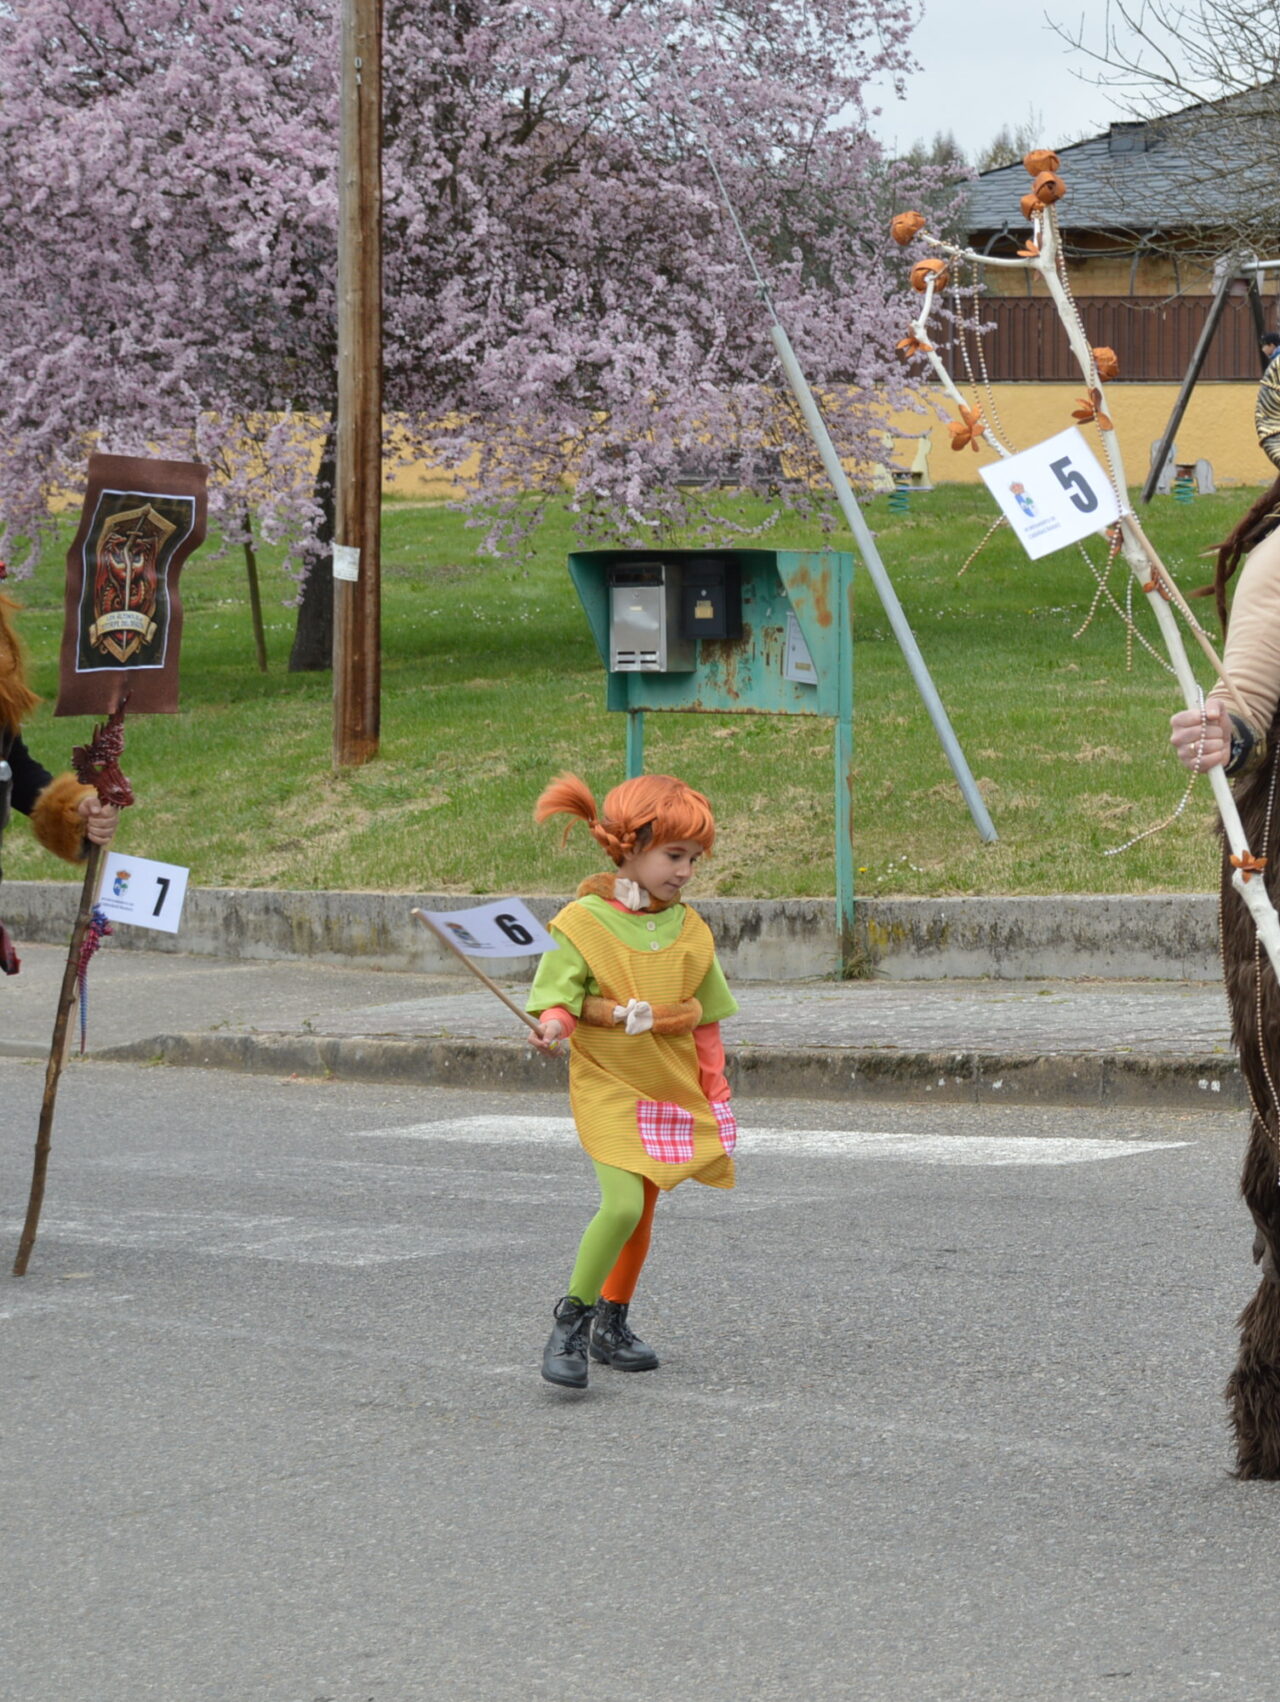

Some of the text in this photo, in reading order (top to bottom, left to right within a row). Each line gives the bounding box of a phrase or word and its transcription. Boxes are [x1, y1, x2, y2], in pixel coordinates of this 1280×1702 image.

[1049, 455, 1098, 513] 5
[153, 877, 169, 916] 7
[495, 914, 533, 945] 6
